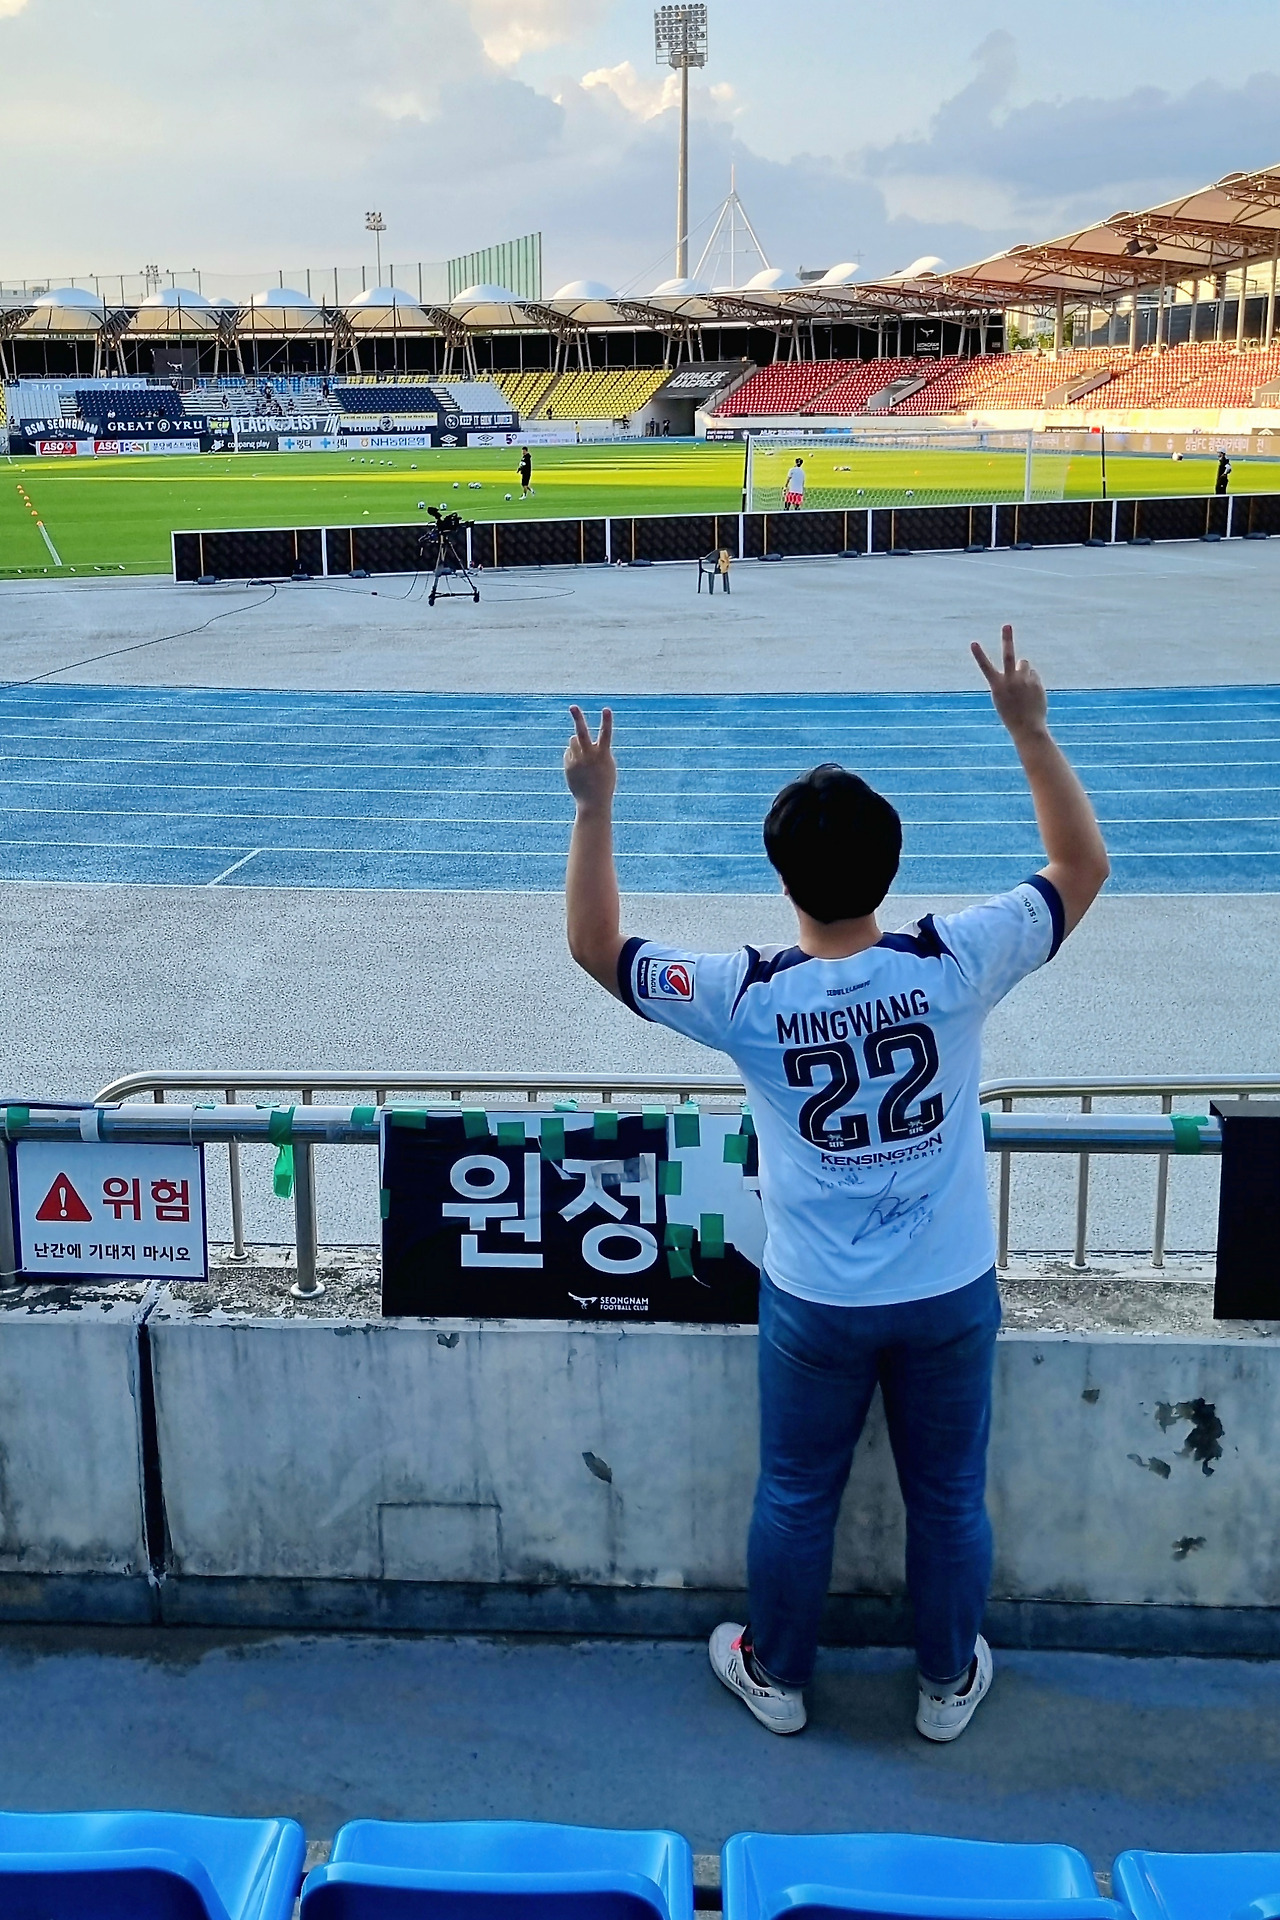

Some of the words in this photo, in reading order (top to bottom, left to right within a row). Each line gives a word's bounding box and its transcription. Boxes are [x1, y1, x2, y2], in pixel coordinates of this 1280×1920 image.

[666, 379, 722, 388] MAGPIES
[675, 371, 710, 380] HOME
[710, 371, 730, 380] OF
[47, 418, 99, 435] SEONGNAM
[107, 420, 155, 431] GREAT
[171, 420, 203, 430] YRU
[43, 441, 64, 451] ASO
[97, 441, 119, 451] ASO
[775, 988, 930, 1045] MINGWANG
[783, 1022, 945, 1153] 22
[820, 1132, 943, 1166] KENSINGTON
[102, 1176, 191, 1223] 위험
[441, 1152, 659, 1275] 원정
[34, 1243, 82, 1260] 난간에
[89, 1244, 136, 1261] 기대지
[143, 1245, 191, 1262] 마시오
[600, 1296, 649, 1305] SEONGNAM
